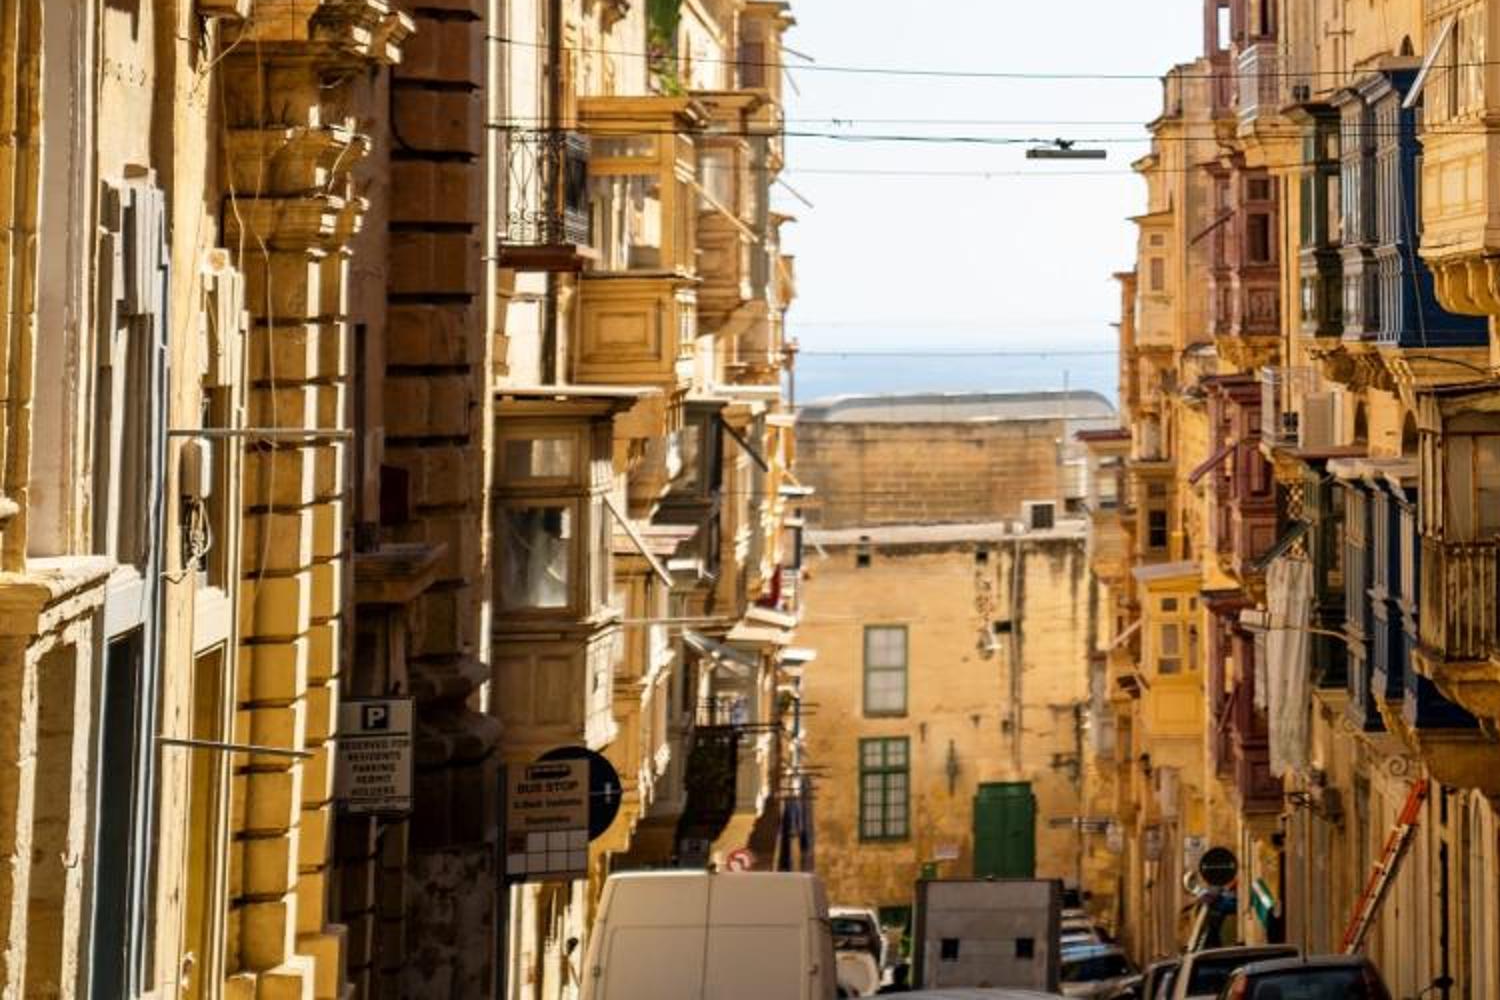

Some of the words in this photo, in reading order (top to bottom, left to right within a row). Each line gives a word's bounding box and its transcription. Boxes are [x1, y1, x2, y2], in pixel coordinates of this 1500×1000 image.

[367, 707, 385, 728] P
[352, 763, 396, 773] PARKING
[356, 774, 391, 784] PERMIT
[517, 783, 542, 794] BUS
[546, 780, 579, 792] STOP
